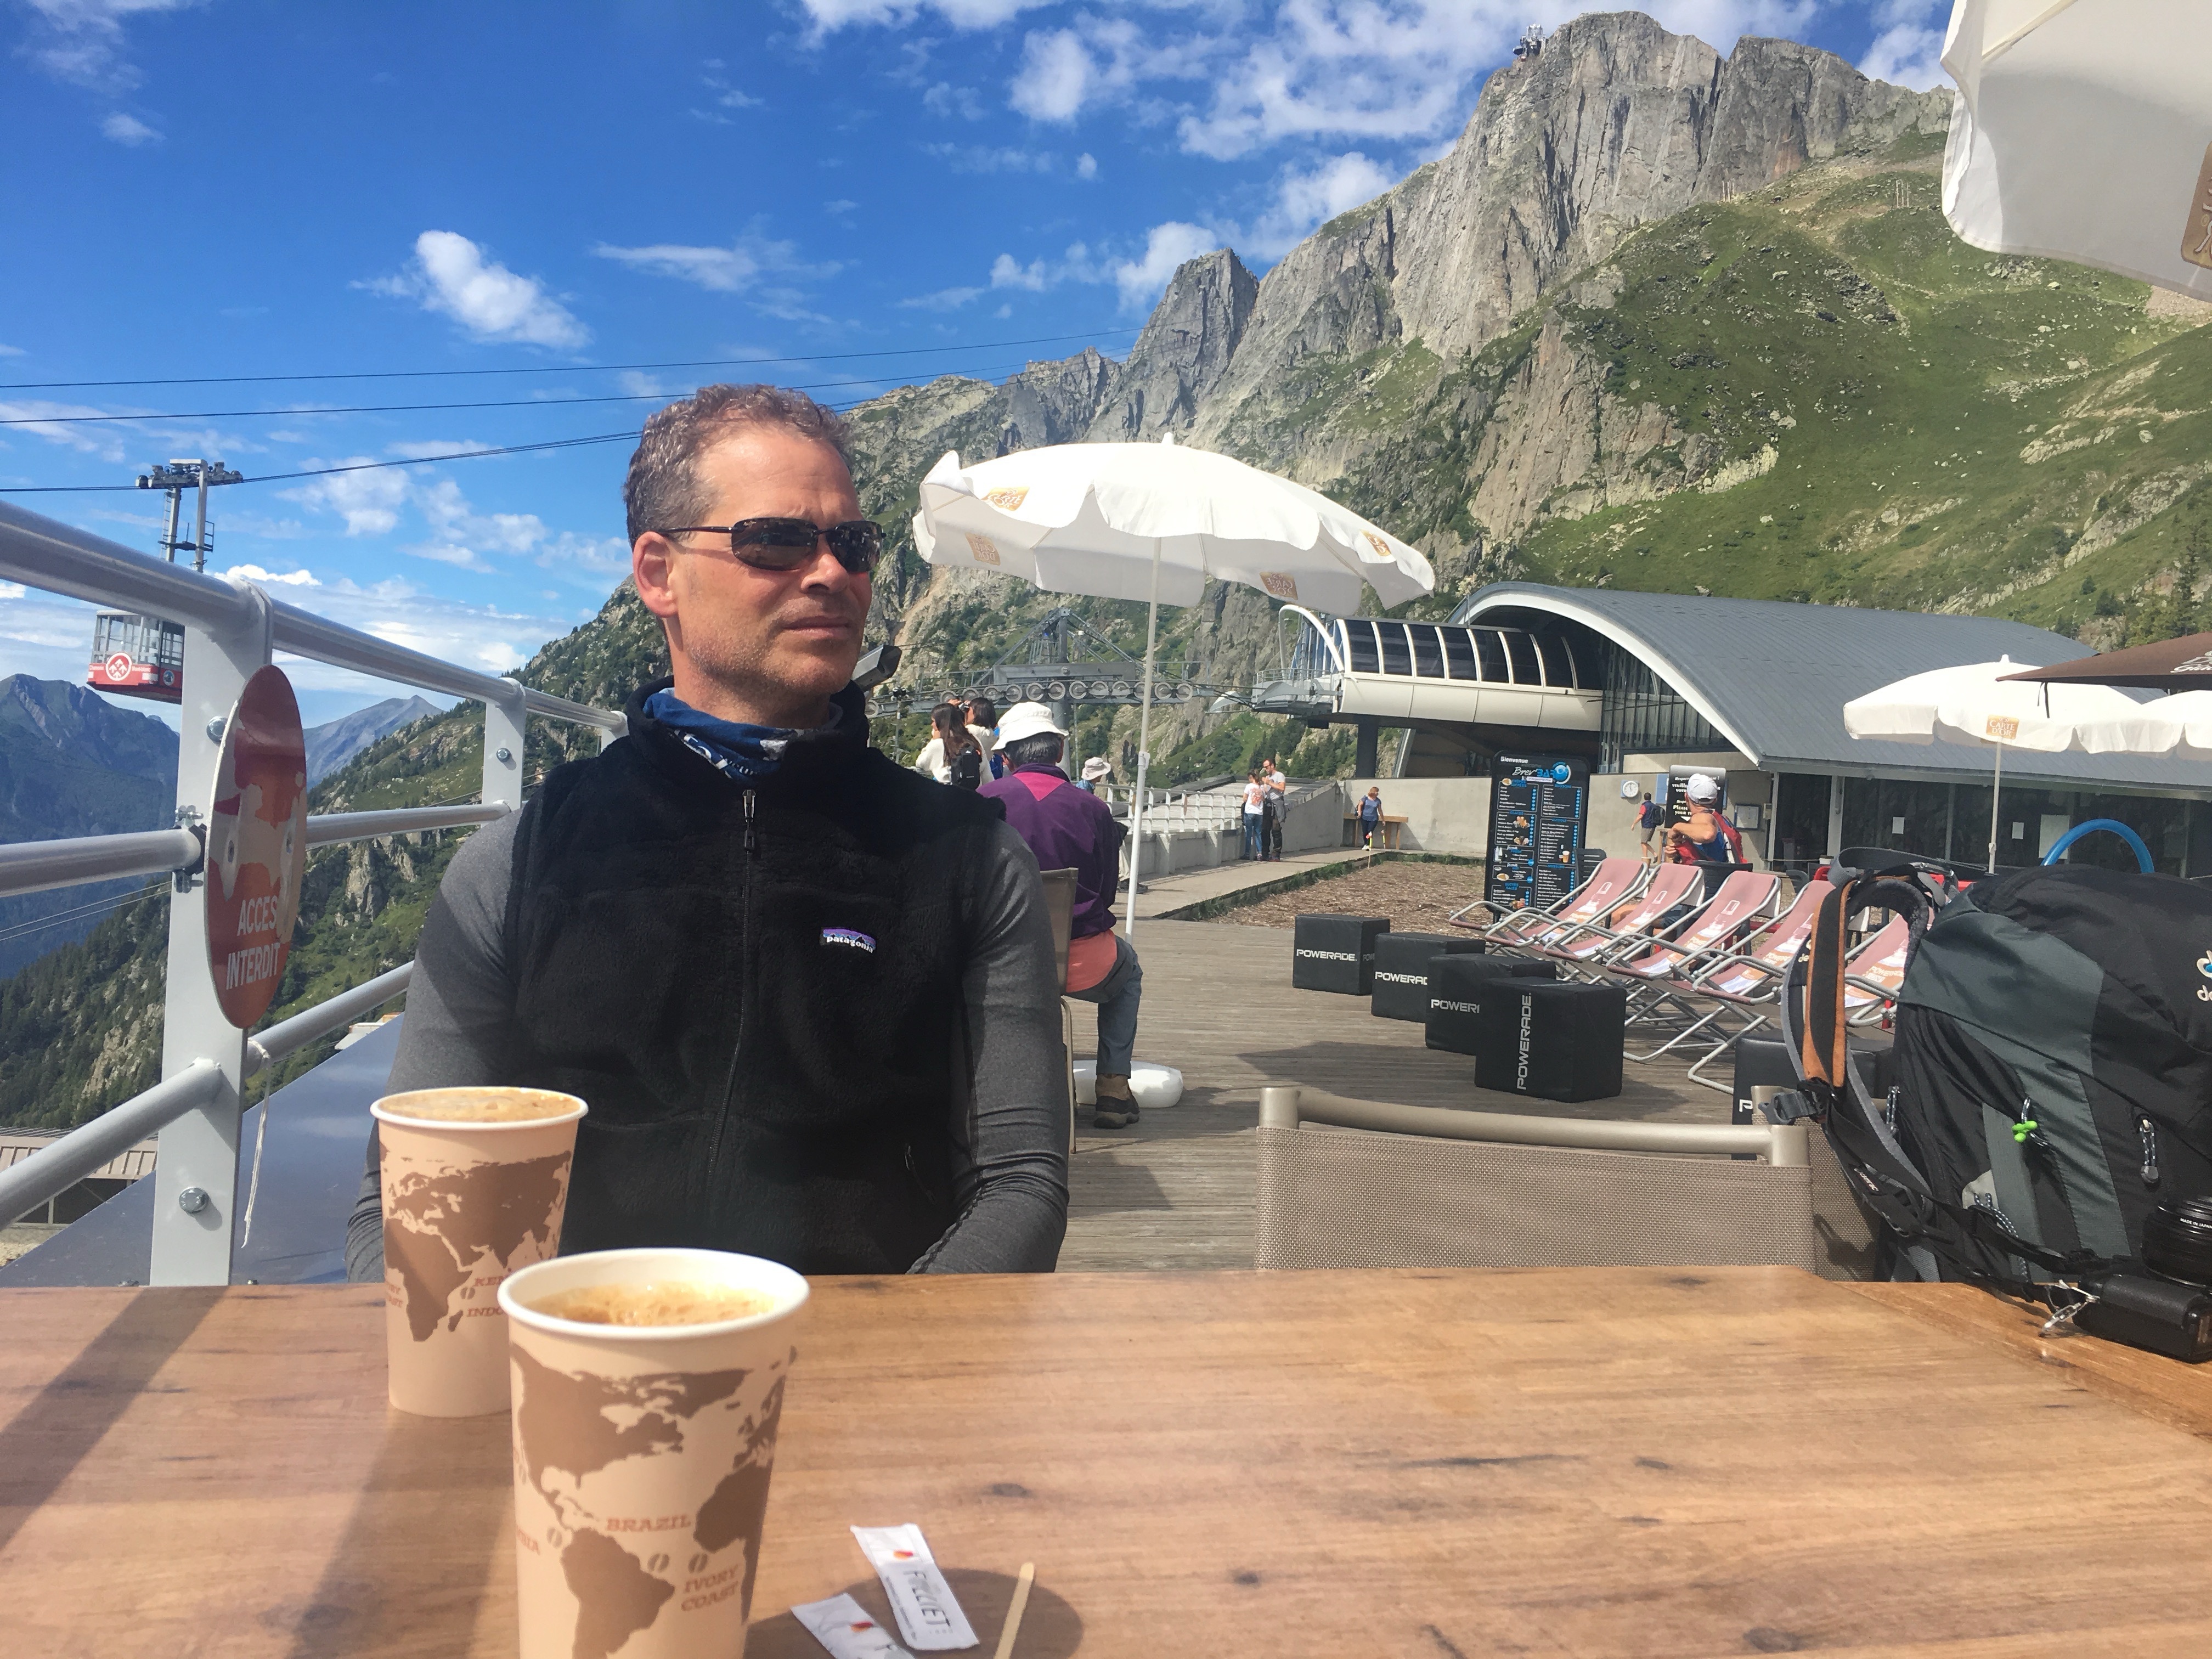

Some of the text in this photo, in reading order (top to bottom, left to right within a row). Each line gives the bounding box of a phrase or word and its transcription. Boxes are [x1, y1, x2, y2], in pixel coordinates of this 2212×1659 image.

[1989, 720, 2016, 731] CARTE
[1992, 727, 2011, 737] D'OR
[237, 895, 278, 936] ACCES
[826, 935, 873, 953] patagonia
[226, 943, 281, 990] INTERDIT
[1431, 999, 1480, 1014] POWER
[606, 1514, 692, 1532] BRAZIL
[685, 1564, 738, 1593] IVORY
[681, 1581, 739, 1611] COAST
